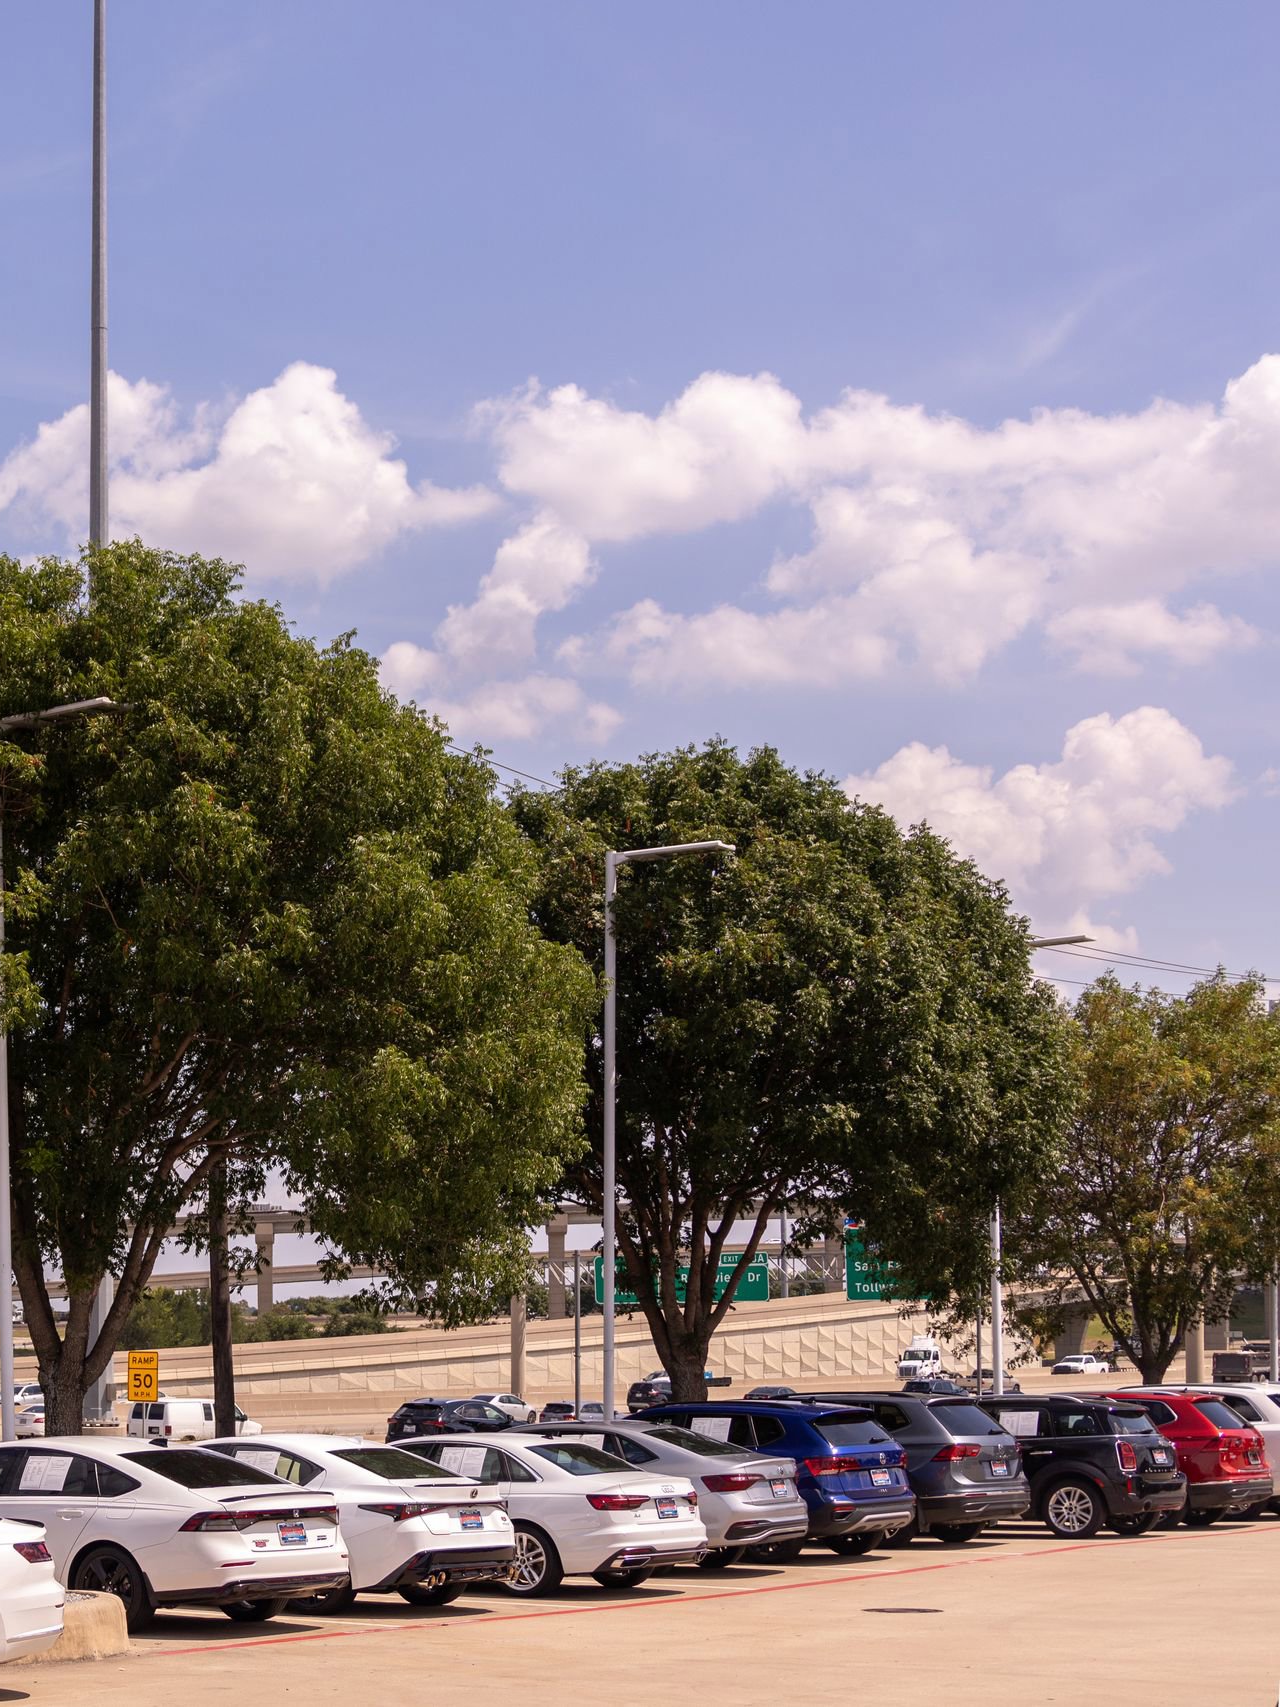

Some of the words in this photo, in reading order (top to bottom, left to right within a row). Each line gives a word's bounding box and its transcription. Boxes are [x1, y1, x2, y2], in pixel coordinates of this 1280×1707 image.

[723, 1255, 739, 1263] EXIT
[747, 1272, 761, 1282] Dr
[855, 1282, 899, 1293] Tollw
[132, 1356, 154, 1364] RAMP
[133, 1373, 153, 1388] 50
